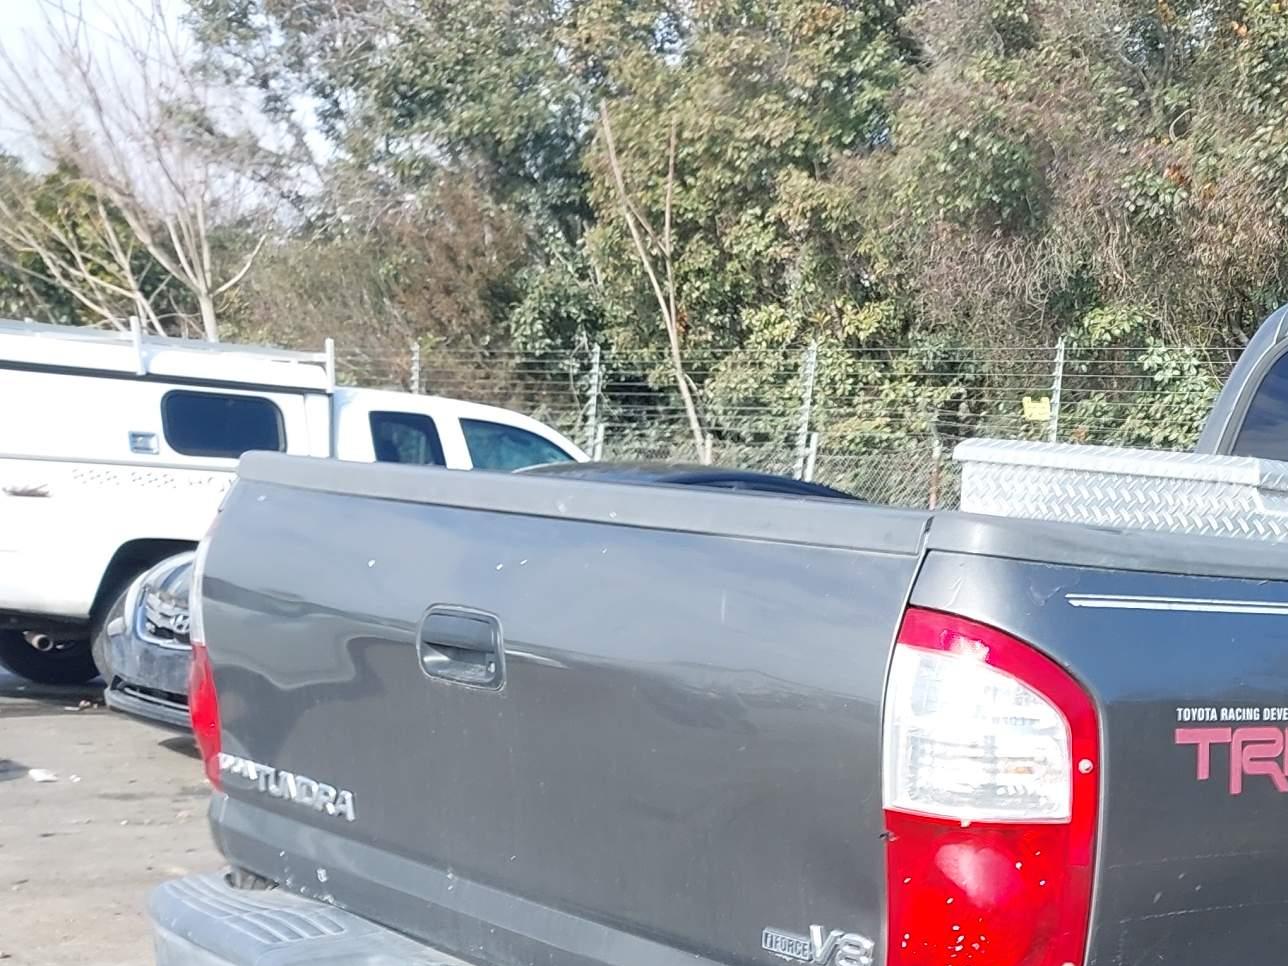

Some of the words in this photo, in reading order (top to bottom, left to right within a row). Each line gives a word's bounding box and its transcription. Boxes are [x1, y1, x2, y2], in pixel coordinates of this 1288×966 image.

[1176, 707, 1218, 721] TOYOTA
[1220, 707, 1260, 721] RACING
[255, 762, 356, 822] TUNDRA
